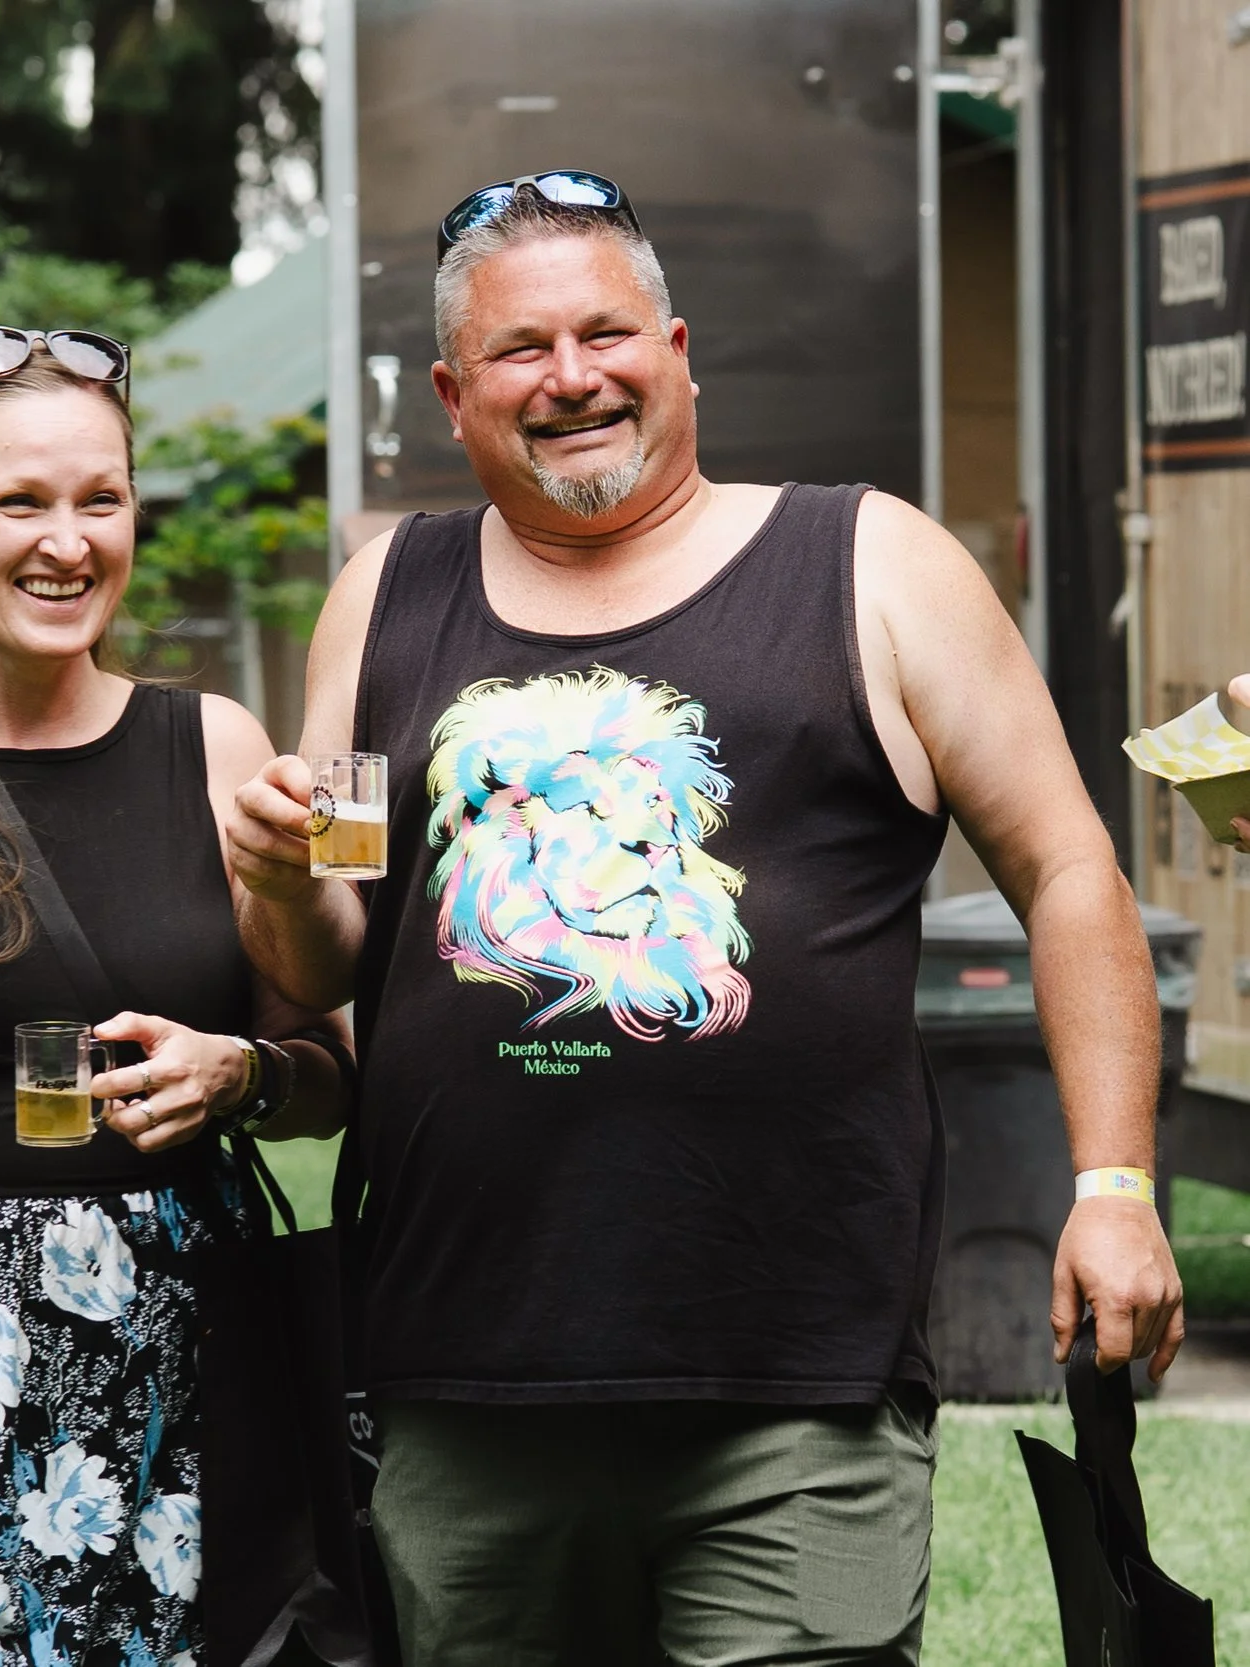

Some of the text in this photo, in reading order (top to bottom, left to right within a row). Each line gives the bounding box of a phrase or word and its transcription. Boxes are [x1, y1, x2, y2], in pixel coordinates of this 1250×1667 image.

[498, 1040, 612, 1058] Puerto Vallarta
[524, 1059, 581, 1076] México
